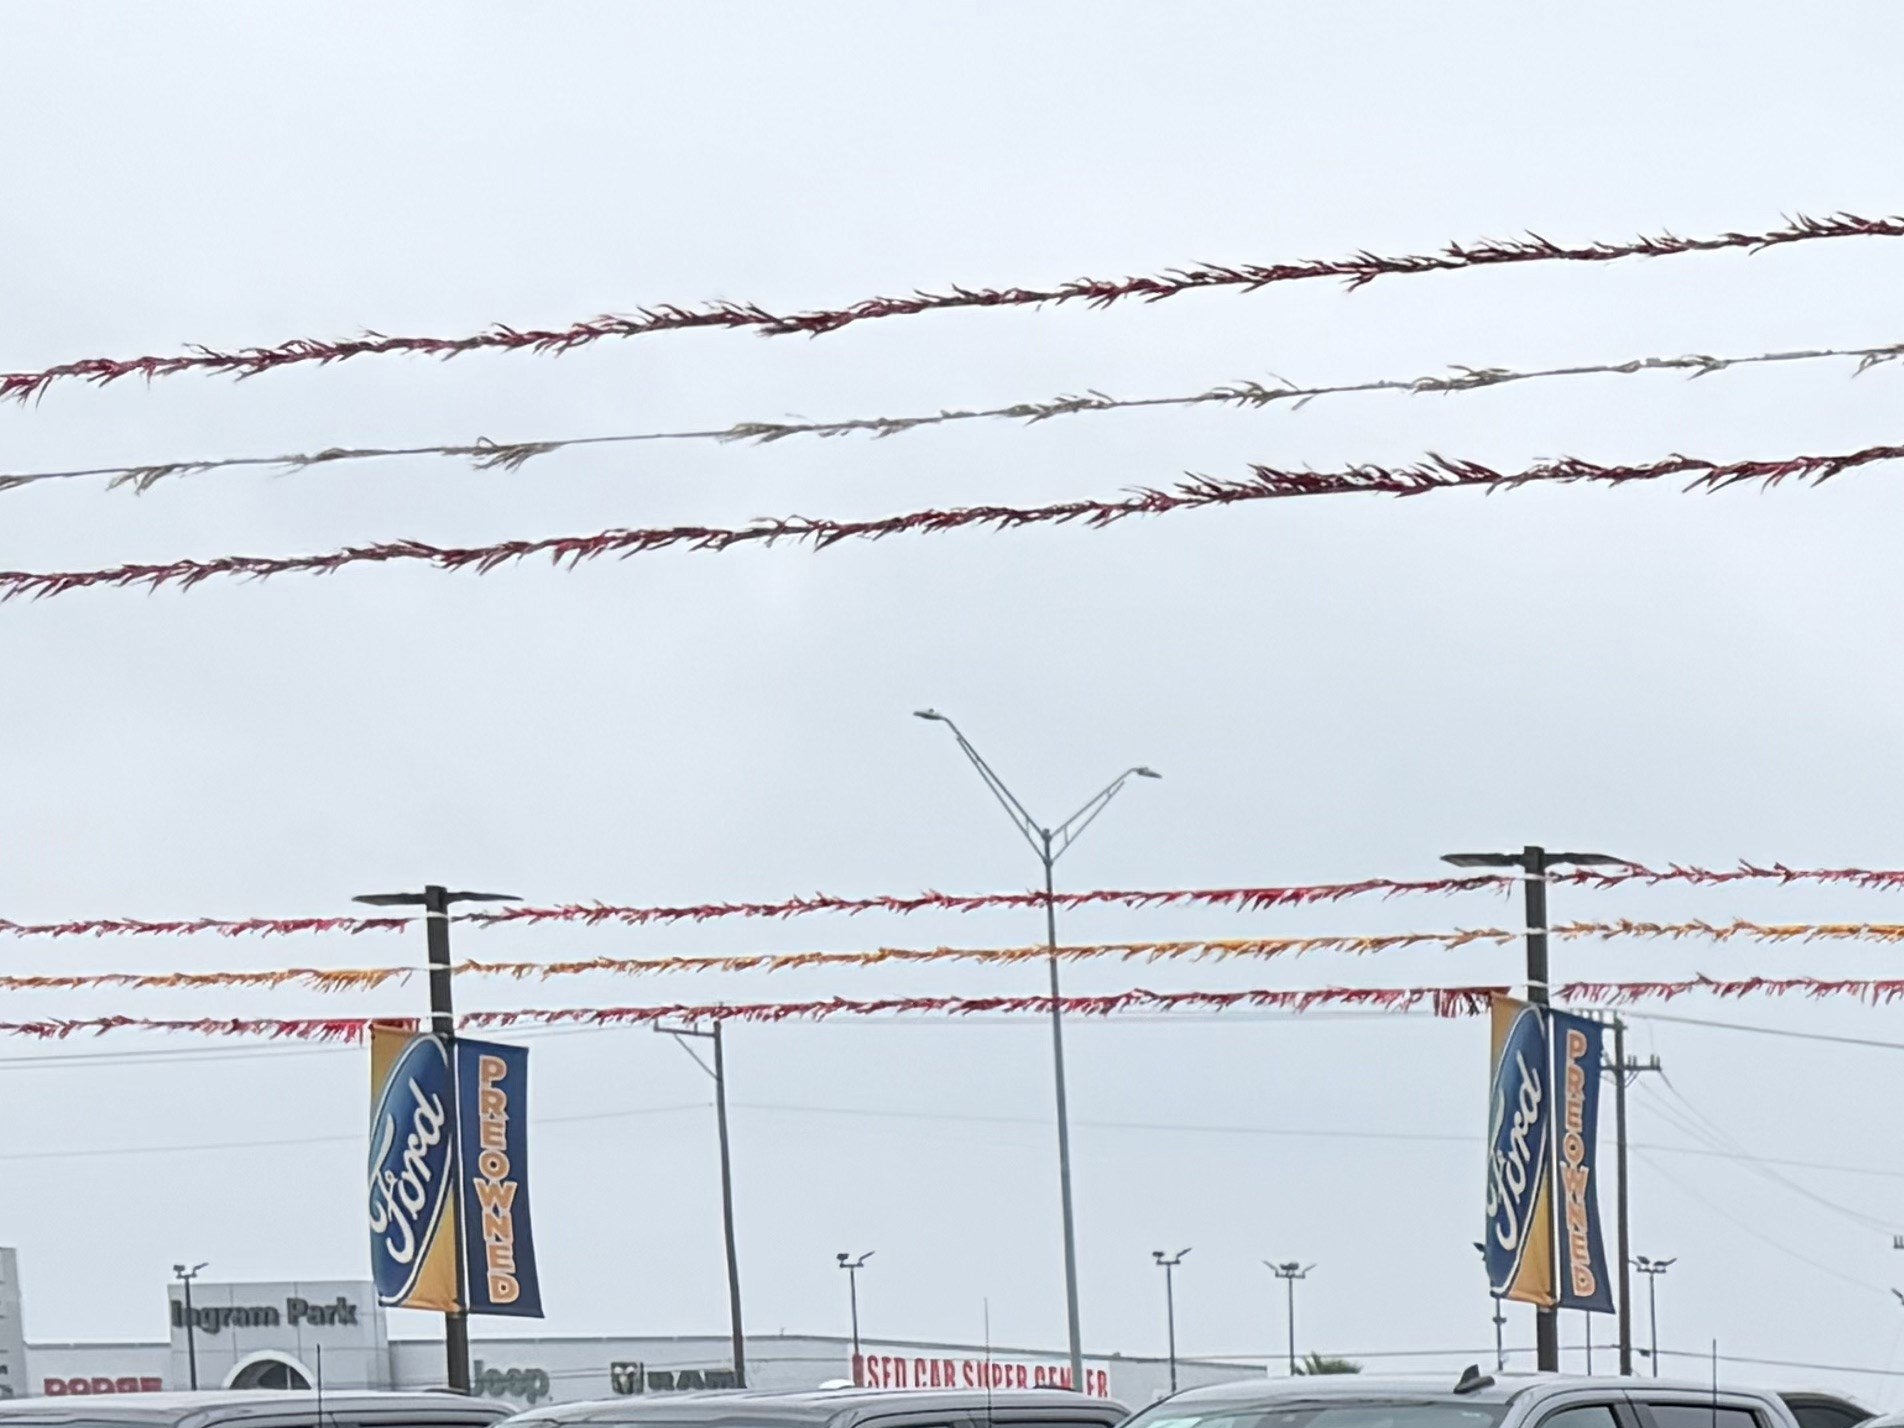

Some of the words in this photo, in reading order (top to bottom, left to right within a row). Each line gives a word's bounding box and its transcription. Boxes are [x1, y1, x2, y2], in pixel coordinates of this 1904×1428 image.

[369, 1075, 445, 1264] Ford
[473, 1054, 520, 1304] PREOWNED
[1487, 1049, 1542, 1251] Ford
[1560, 1028, 1597, 1297] PREOWNED
[170, 1299, 281, 1334] Ingram
[286, 1296, 358, 1327] Park
[44, 1376, 163, 1396] DODGE
[472, 1359, 551, 1404] Jeep
[852, 1353, 907, 1389] USED
[914, 1357, 956, 1388] CAR
[963, 1358, 1027, 1389] SUPER
[1034, 1365, 1108, 1398] CENER
